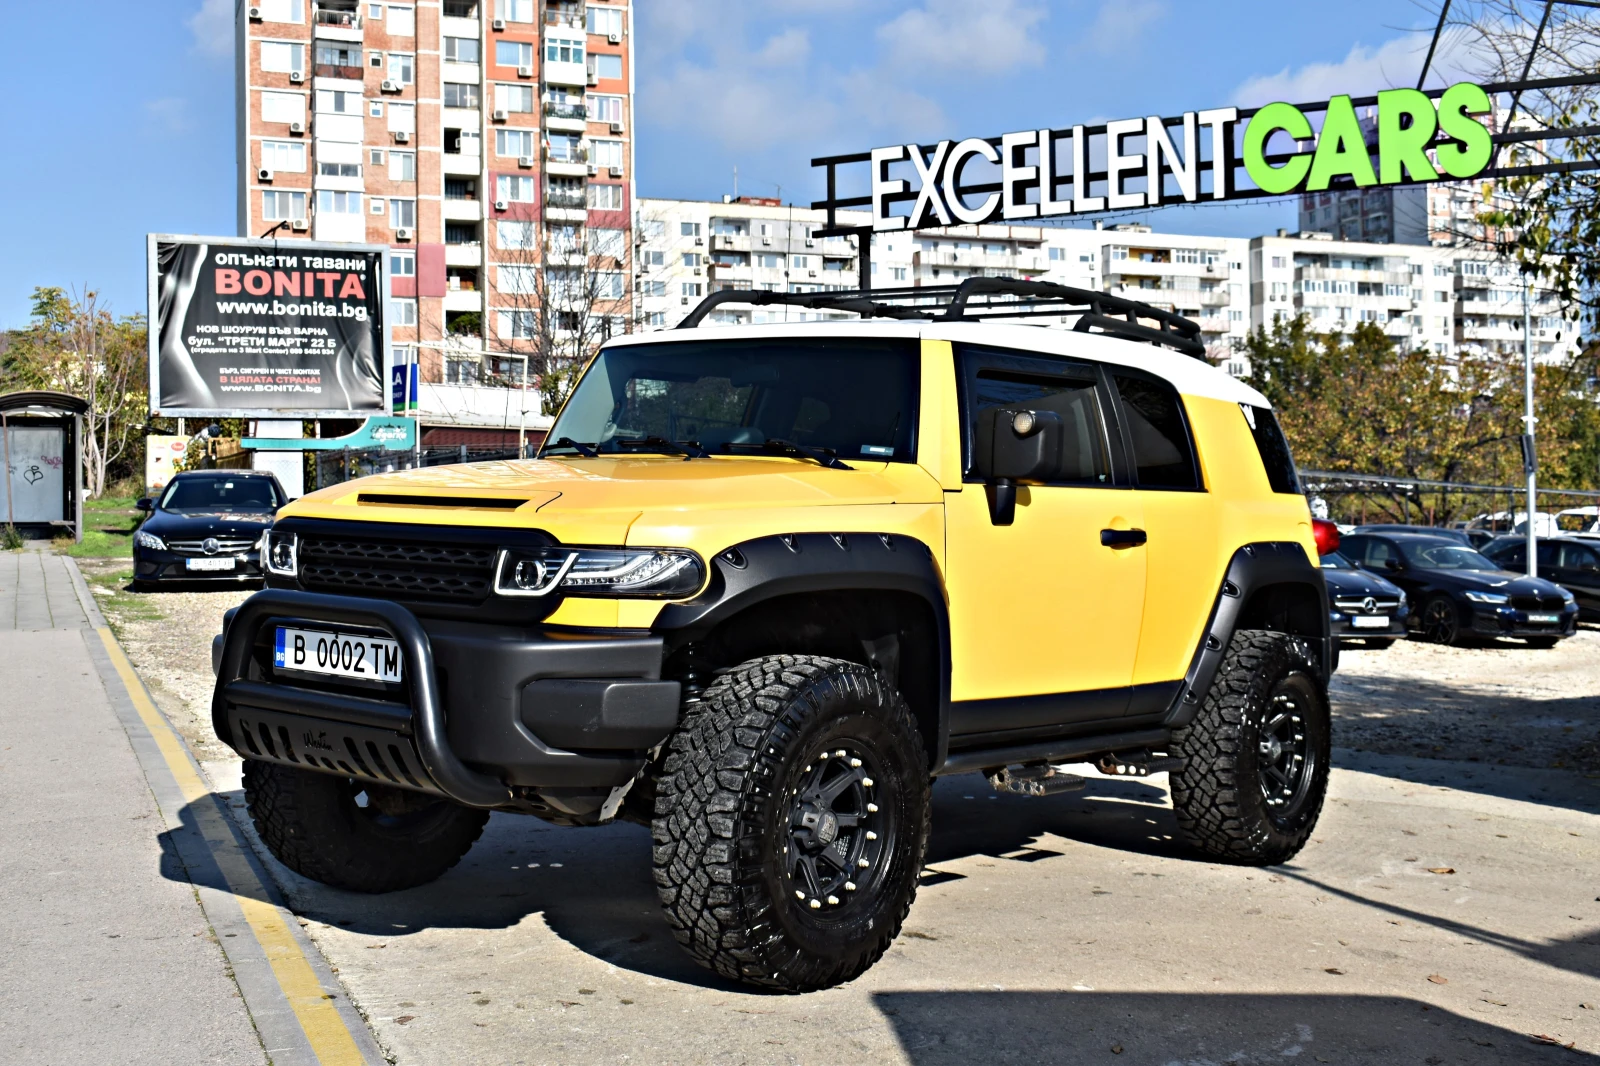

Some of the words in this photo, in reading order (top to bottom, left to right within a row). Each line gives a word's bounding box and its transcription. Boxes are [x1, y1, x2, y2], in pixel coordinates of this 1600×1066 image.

[870, 106, 1238, 231] EXCELLENT
[1242, 82, 1493, 194] CARS
[215, 253, 297, 267] опънати
[302, 257, 365, 270] тавани
[215, 268, 366, 299] BONITA
[216, 300, 368, 321] www.bonita.bg
[197, 325, 219, 333] НОВ
[222, 326, 266, 334] ШОУРУМ
[269, 327, 291, 335] ВЪВ
[293, 327, 328, 335] ВАРНА
[188, 336, 214, 346] бул.
[311, 339, 324, 347] 22
[328, 339, 336, 347] Б
[220, 376, 228, 384] В
[230, 376, 274, 384] ЦЯЛАТА
[276, 651, 285, 662] BG
[294, 634, 305, 665] B
[316, 637, 365, 673] 0002
[371, 643, 397, 677] TM
